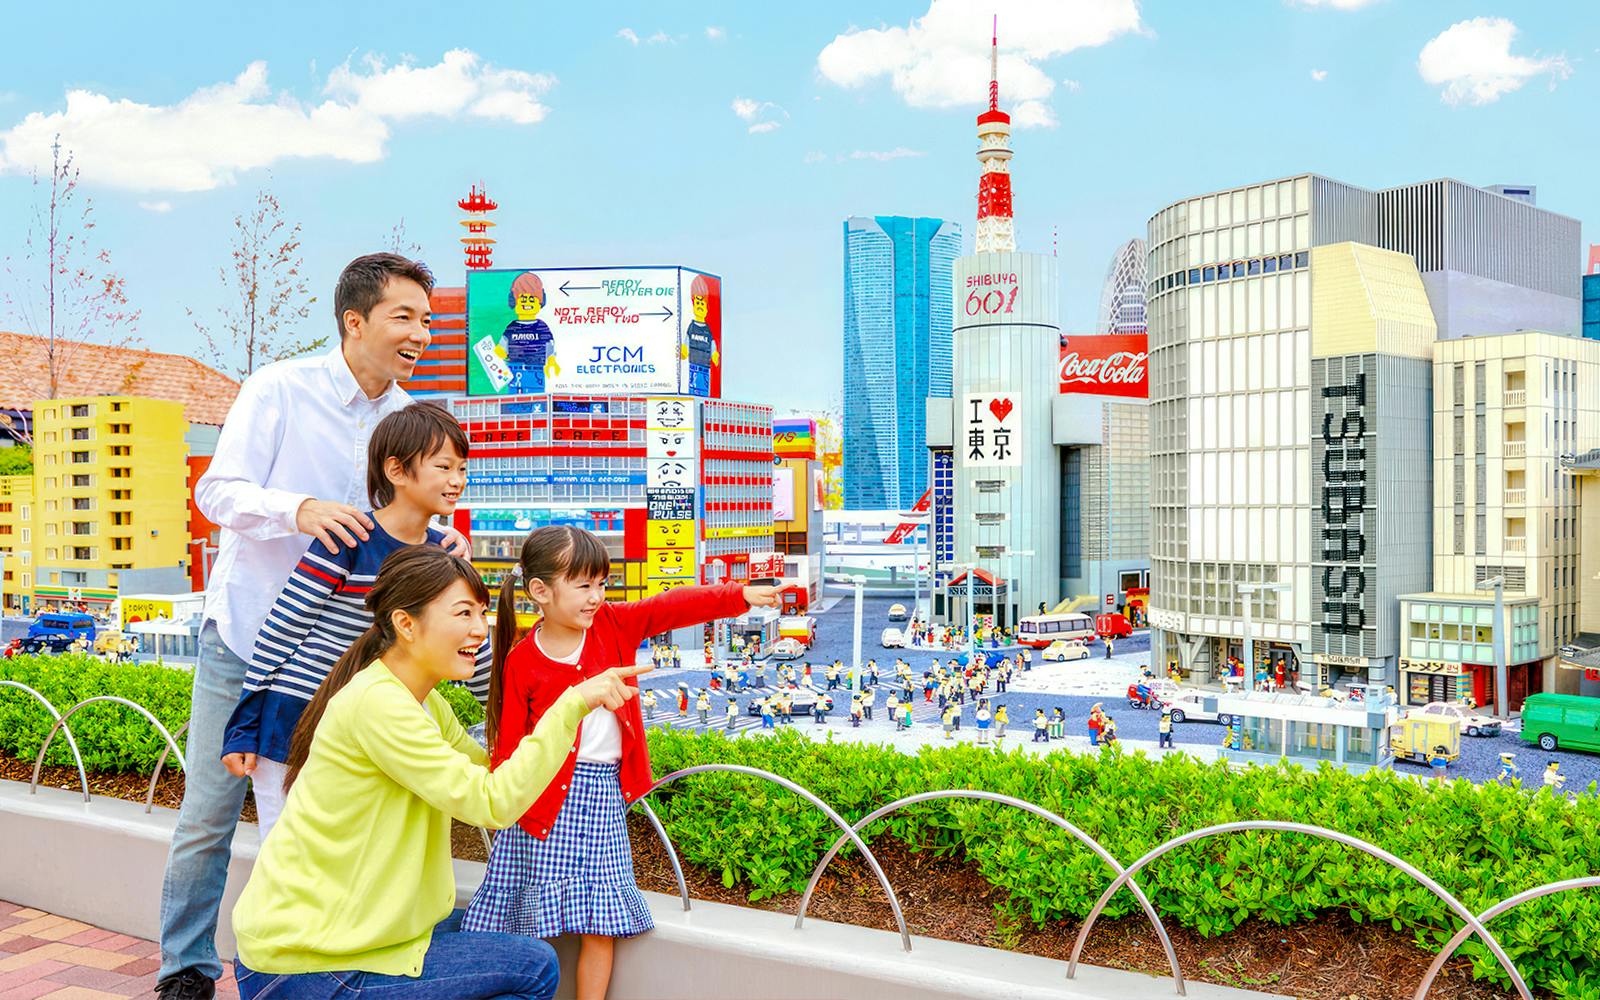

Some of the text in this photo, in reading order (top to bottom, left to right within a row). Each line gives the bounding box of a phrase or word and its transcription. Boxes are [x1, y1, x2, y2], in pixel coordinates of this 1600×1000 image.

[602, 279, 642, 288] READY
[966, 273, 1017, 287] SHIBUYA
[607, 284, 653, 296] PLAYER
[965, 286, 1019, 316] 601
[554, 306, 628, 316] NOT READY
[559, 314, 640, 324] PLAYER TWO
[589, 345, 643, 363] JCM
[576, 364, 656, 374] ELECTRONICS
[1058, 351, 1148, 384] Coca-Cola
[470, 431, 524, 442] CAFE
[553, 431, 621, 441] CAFE
[968, 427, 1012, 461] 東京
[653, 510, 692, 520] PULSE
[1400, 659, 1445, 672] ラーメン
